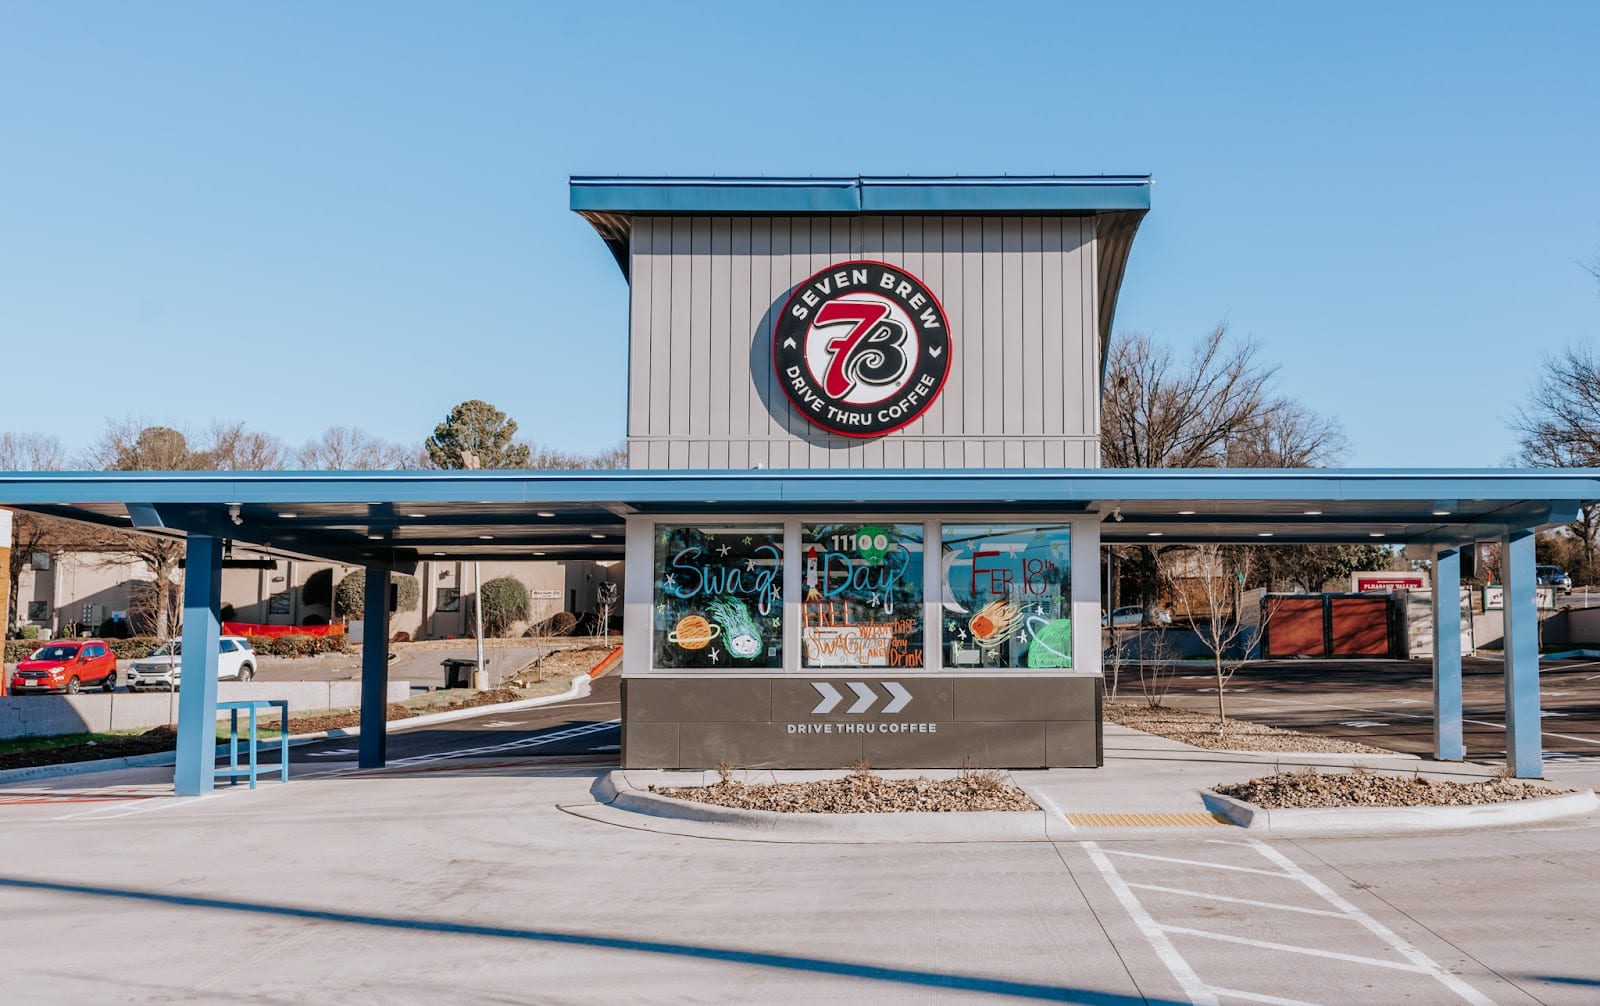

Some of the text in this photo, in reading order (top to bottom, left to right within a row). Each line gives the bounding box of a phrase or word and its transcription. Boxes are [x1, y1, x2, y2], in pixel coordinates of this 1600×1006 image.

[792, 269, 940, 329] SEVEN BREW
[813, 300, 908, 400] 7B
[786, 365, 936, 425] DRIVE THRU COFFEE
[831, 534, 888, 551] 11100
[672, 543, 911, 616] Swag Day
[1021, 557, 1055, 596] 18th
[803, 598, 857, 628] FREE
[787, 723, 937, 734] DRIVE THRU COFFEE
